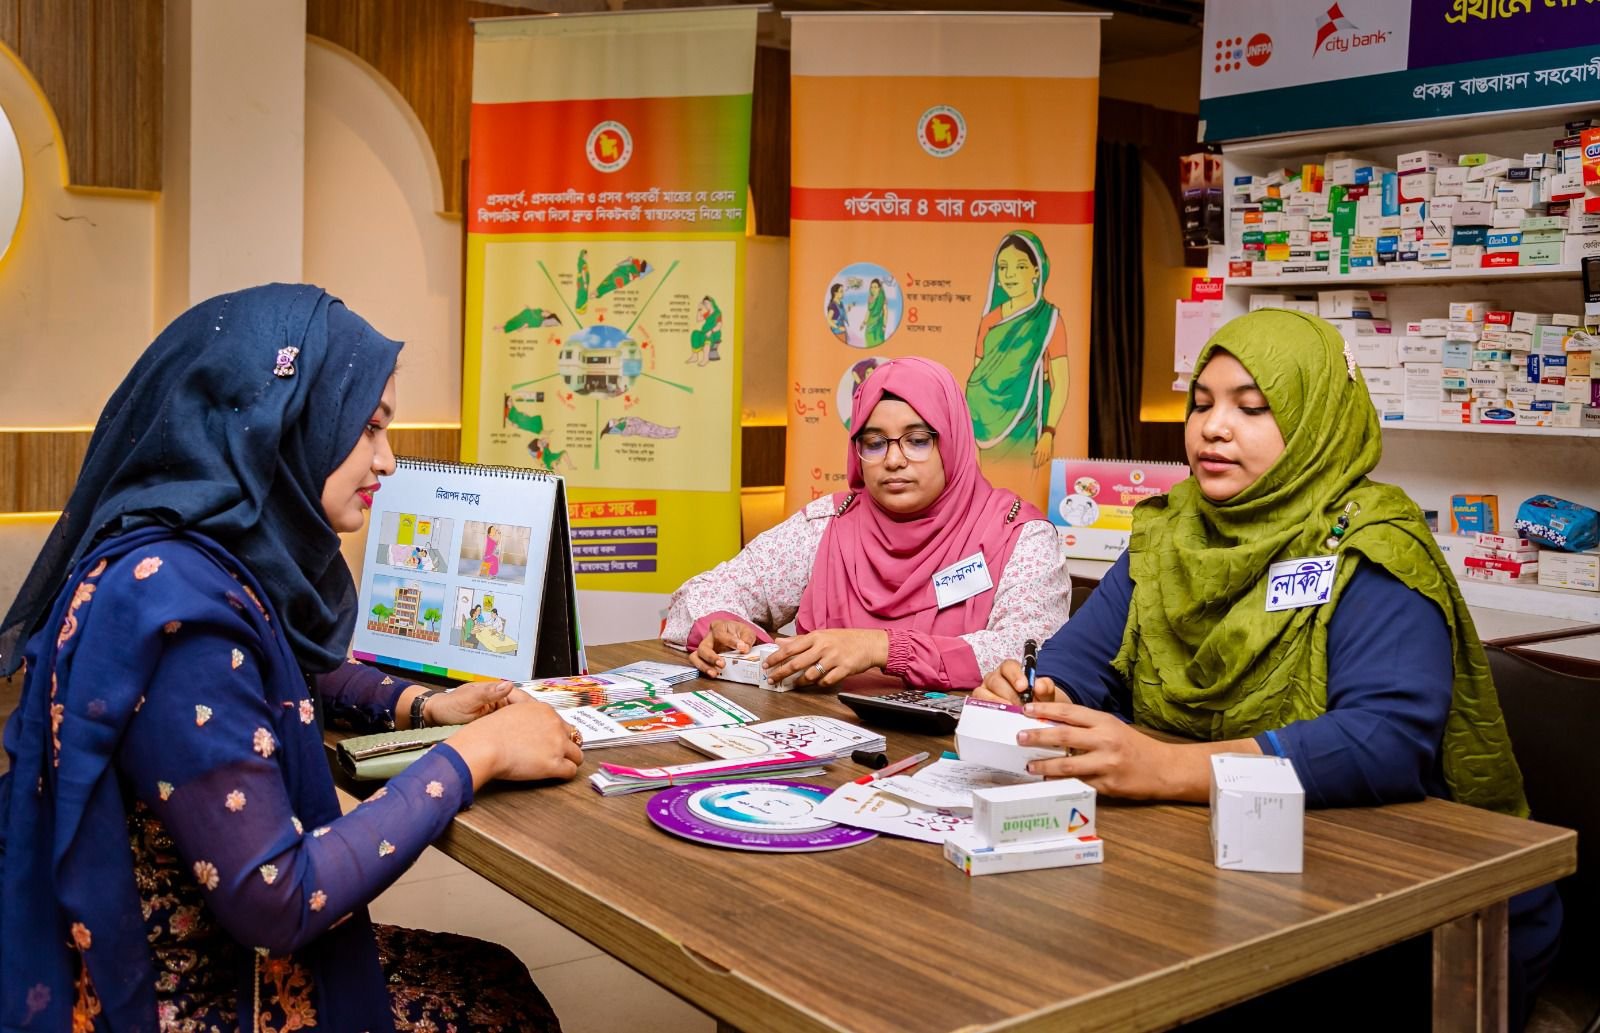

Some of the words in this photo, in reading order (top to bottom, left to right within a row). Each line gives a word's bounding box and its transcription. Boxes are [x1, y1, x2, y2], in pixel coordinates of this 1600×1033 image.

[1325, 36, 1350, 52] city
[1352, 29, 1387, 48] bank
[1247, 42, 1273, 57] UNFPA
[1412, 81, 1456, 101] প্রকল্প
[1459, 72, 1531, 96] বাস্তবায়ন
[587, 192, 596, 204] ও
[843, 191, 913, 217] গর্ভবতীর
[916, 198, 929, 217] ৪
[935, 197, 965, 217] বার
[969, 198, 1037, 219] চেকআপ
[435, 486, 459, 502] নিরাপদ
[1002, 816, 1061, 833] Vitabion
